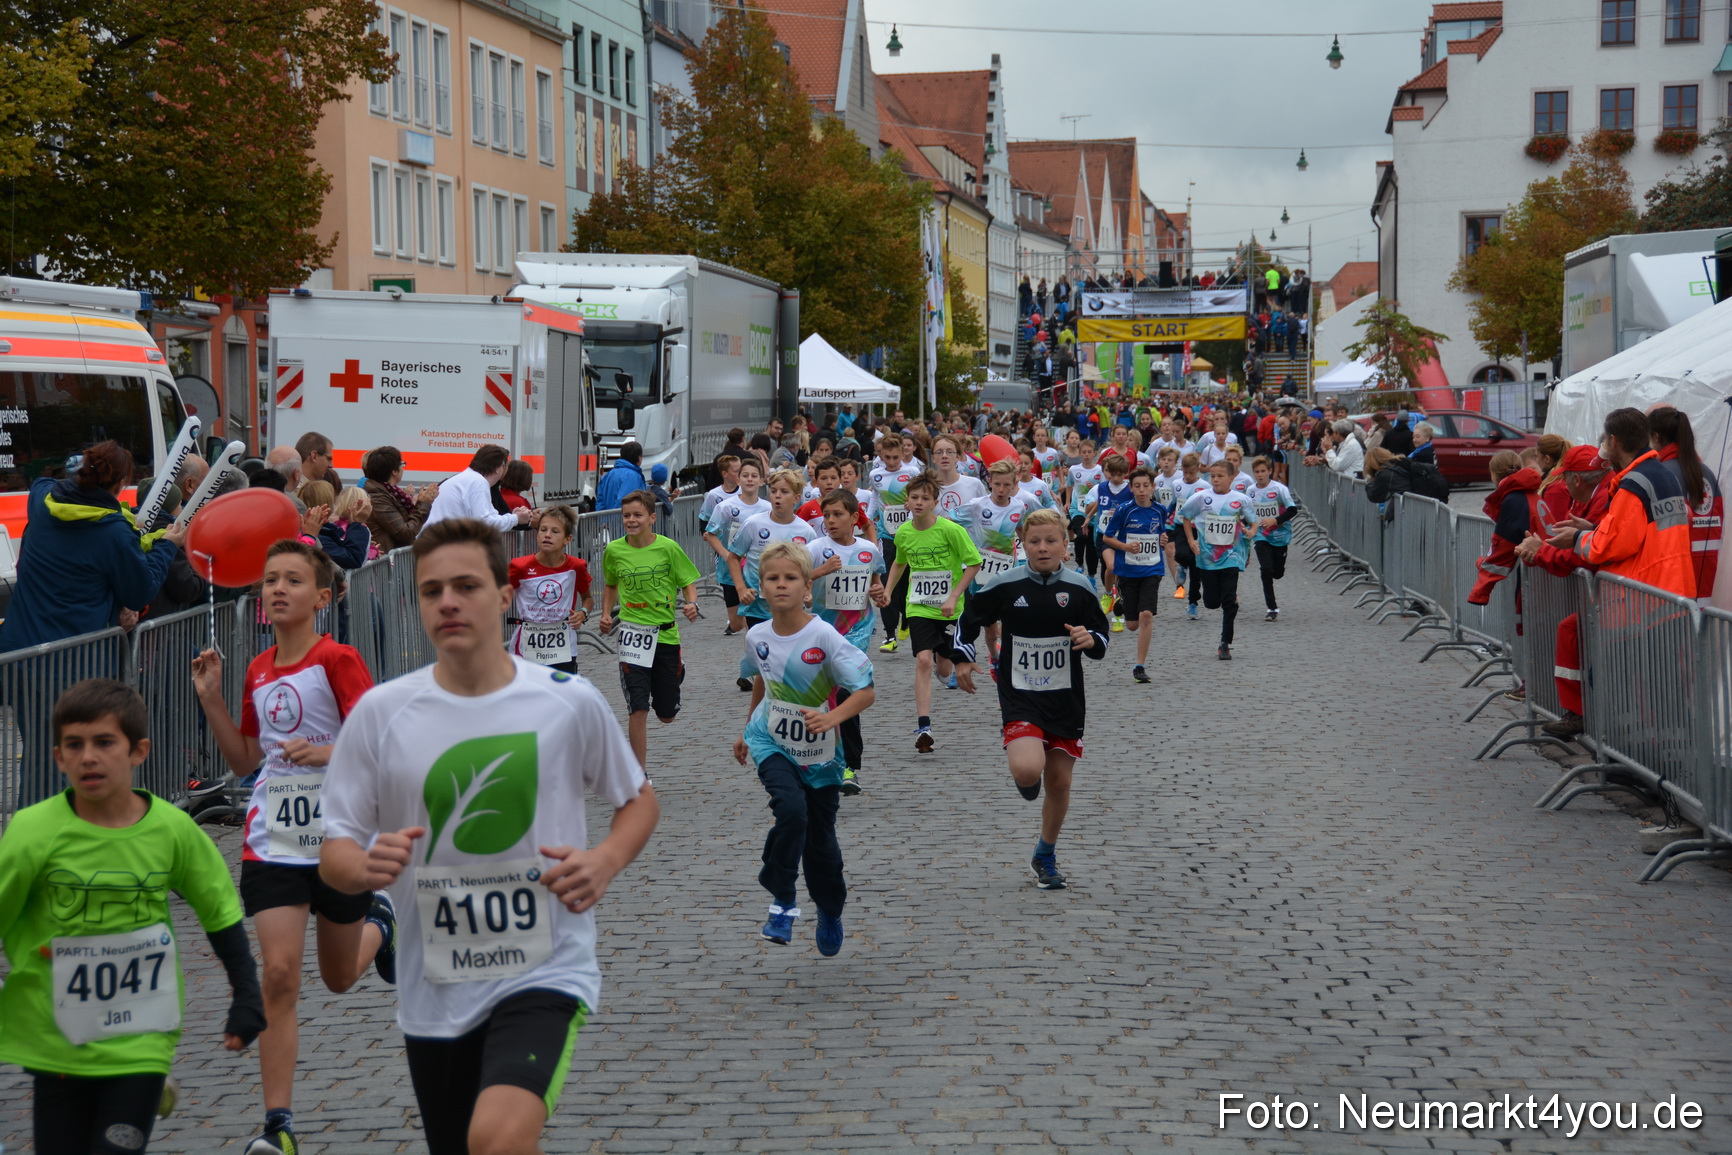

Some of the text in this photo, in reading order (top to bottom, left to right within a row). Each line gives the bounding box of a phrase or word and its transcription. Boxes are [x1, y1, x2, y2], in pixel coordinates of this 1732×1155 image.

[1132, 323, 1189, 337] START
[480, 348, 508, 356] 44/54/1
[381, 360, 462, 374] Bayerisches
[381, 377, 418, 388] Rotes
[380, 393, 418, 405] Kreuz
[803, 388, 856, 400] Laufsport
[421, 430, 505, 440] Katastrophenschutz
[428, 440, 465, 448] Freistaat
[1099, 495, 1110, 506] 13
[1255, 507, 1277, 517] 4000
[1208, 522, 1234, 534] 4102
[831, 576, 868, 593] 4117
[914, 580, 949, 596] 4029
[834, 595, 865, 606] LUKAS
[528, 632, 566, 649] 4028
[618, 630, 653, 651] 4039
[1014, 640, 1032, 649] PARTL
[1018, 649, 1065, 670] 4100
[1022, 673, 1051, 686] FELIX
[772, 705, 794, 716] PARTL
[306, 733, 332, 743] HERZ
[780, 745, 824, 758] Sebastian
[268, 783, 296, 794] PARTL
[417, 872, 522, 889] PARTL Neumarkt
[434, 887, 537, 935] 4109
[56, 938, 157, 957] PARTL Neumarkt
[452, 945, 526, 970] Maxim
[67, 951, 166, 1002] 4047
[104, 1009, 132, 1026] Jan
